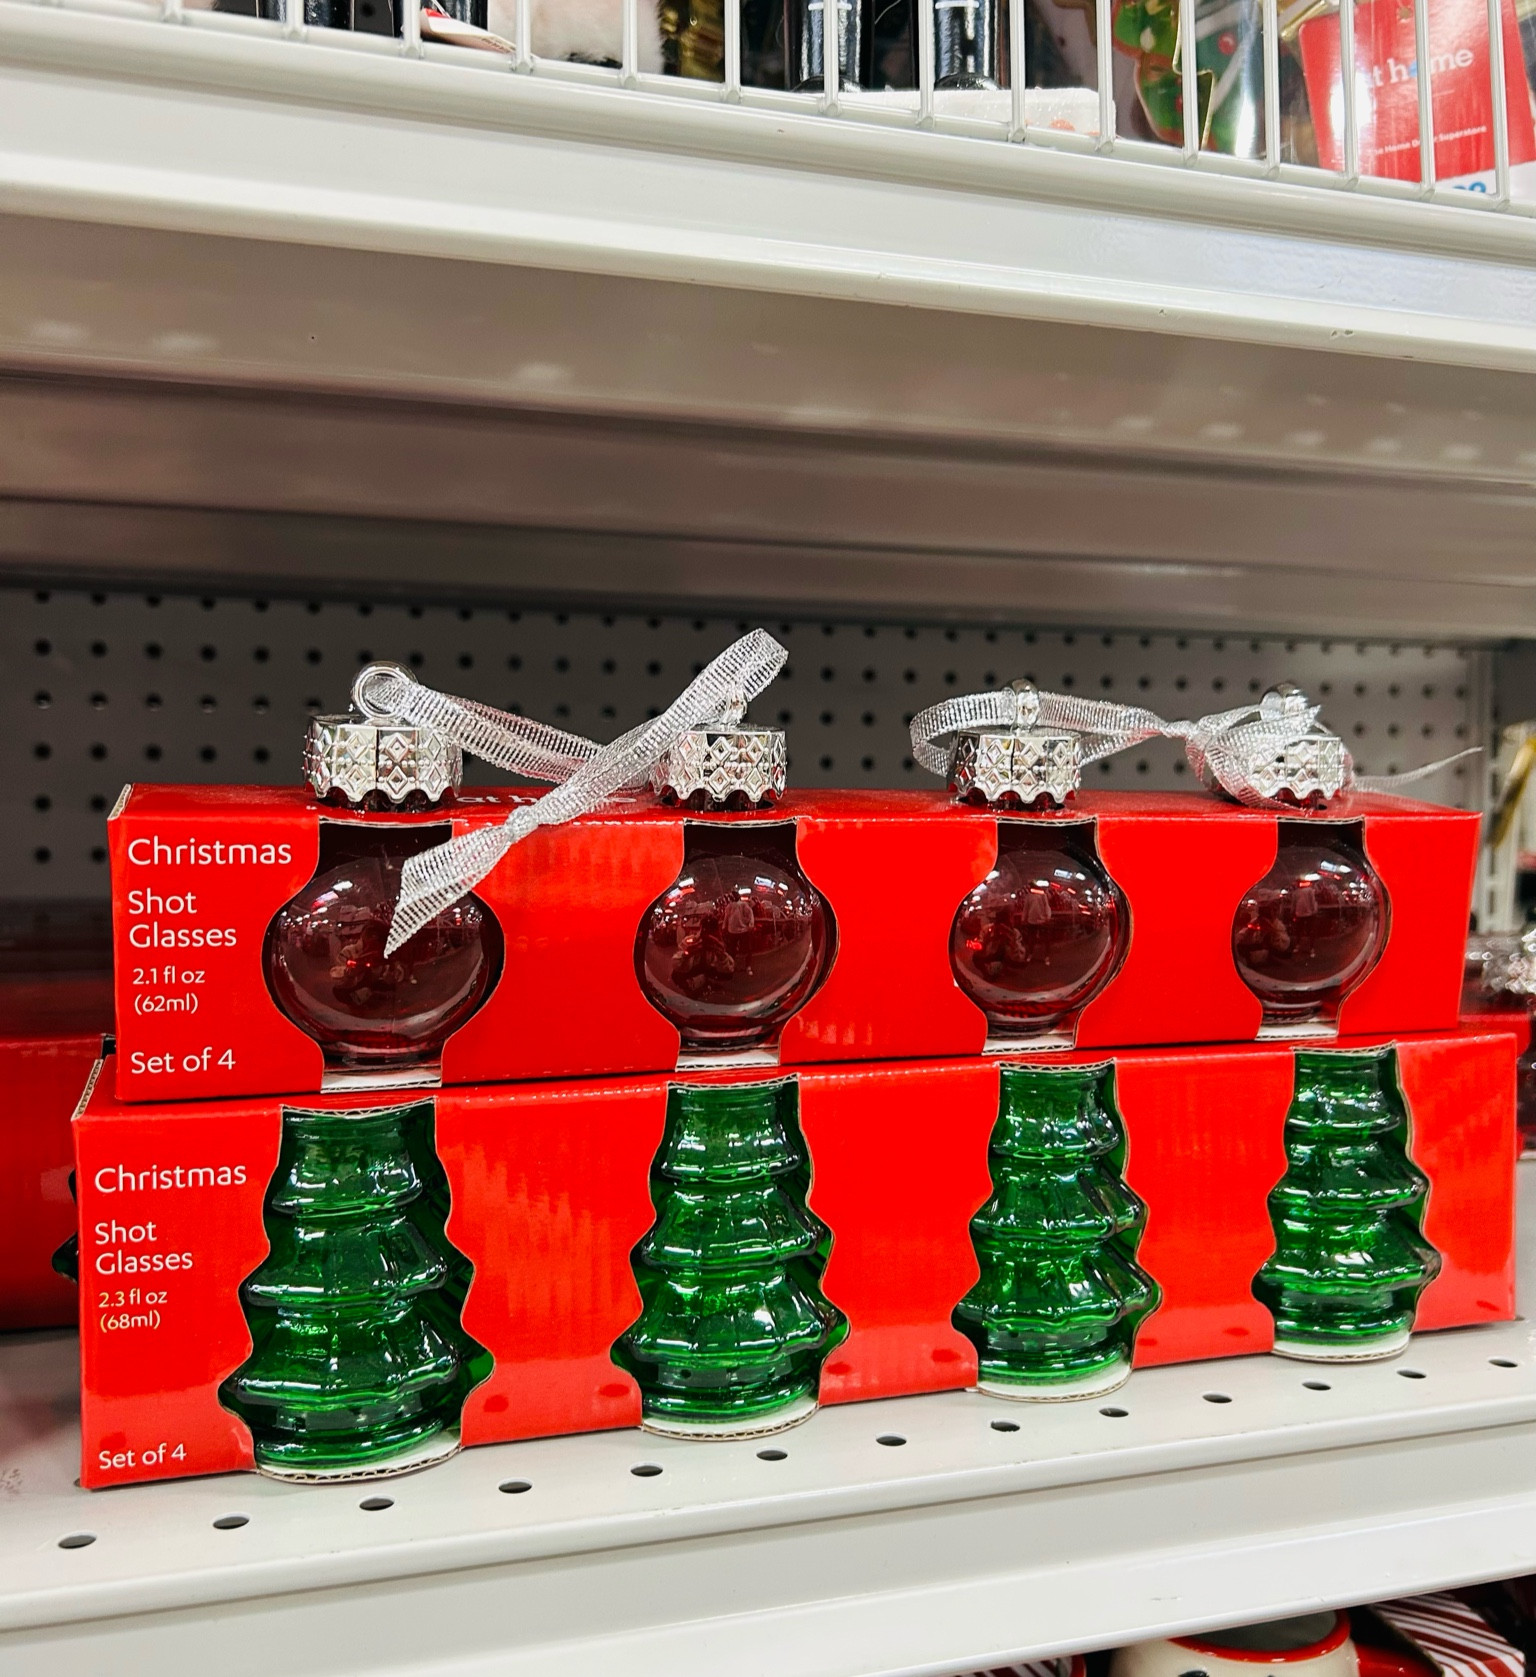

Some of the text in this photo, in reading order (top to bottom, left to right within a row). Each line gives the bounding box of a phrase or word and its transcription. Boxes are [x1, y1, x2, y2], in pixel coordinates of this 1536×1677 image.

[1439, 125, 1488, 142] Superstore
[128, 835, 293, 866] Christmas
[128, 887, 198, 915] Shot
[129, 921, 238, 948] Glasses
[132, 965, 206, 985] 2.1 fl oz
[134, 993, 199, 1015] (62ml)
[131, 1046, 237, 1074] Set of 4
[94, 1164, 247, 1194] Christmas
[94, 1219, 157, 1245] Shot
[95, 1251, 194, 1276] Glasses
[98, 1288, 168, 1308] 2.3 fl oz
[99, 1309, 161, 1333] (68ml)
[98, 1442, 188, 1470] Set of 4
